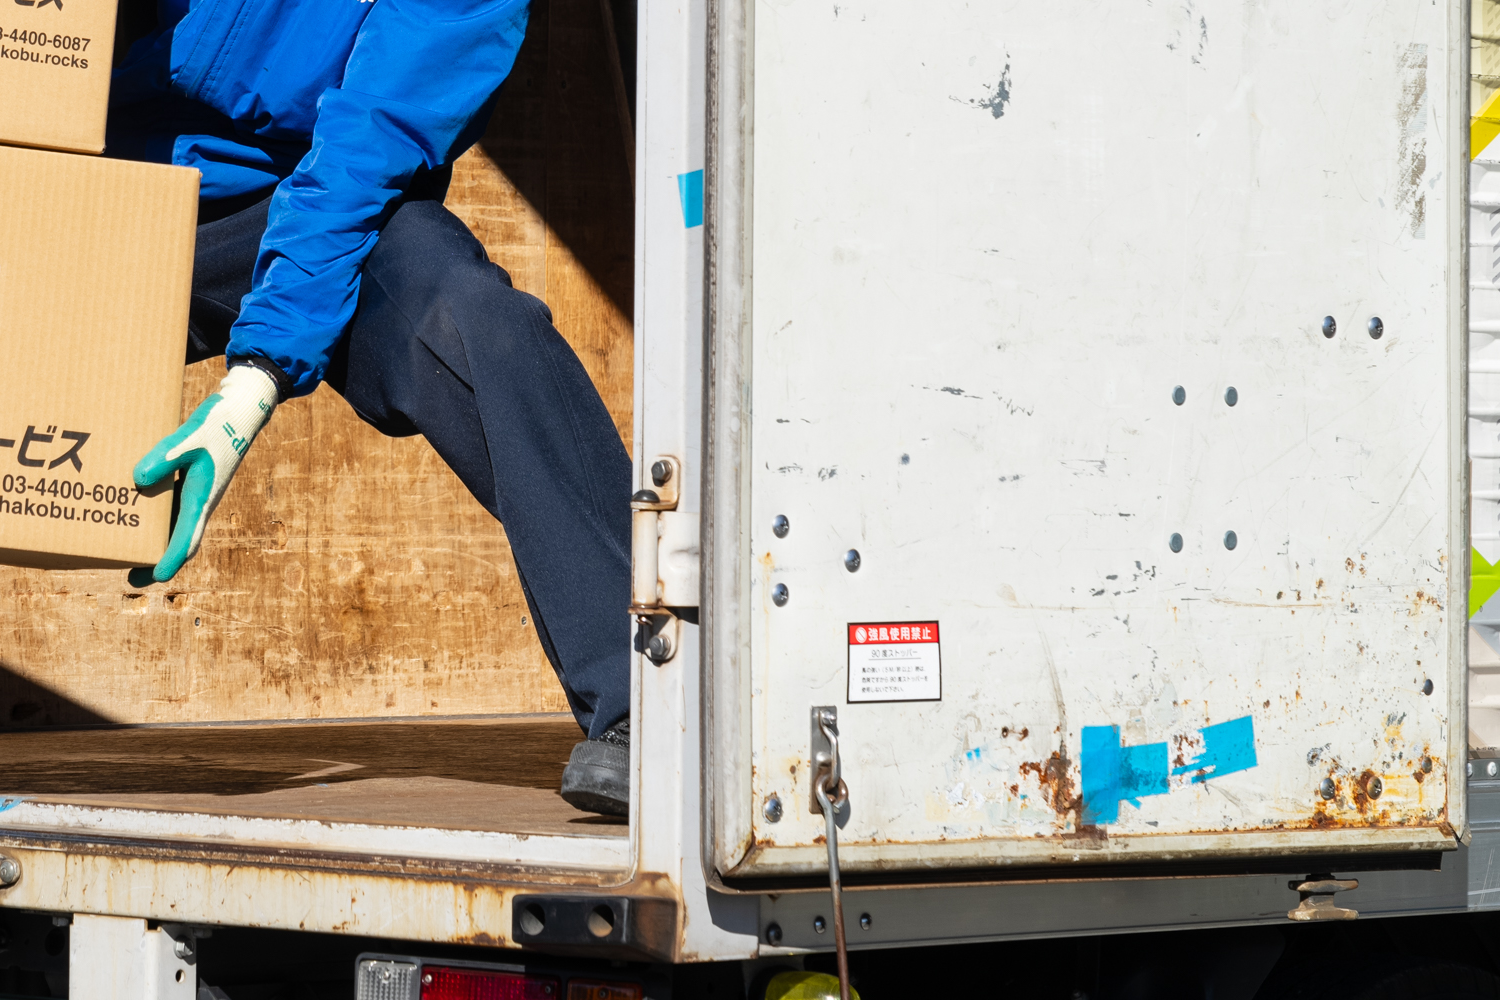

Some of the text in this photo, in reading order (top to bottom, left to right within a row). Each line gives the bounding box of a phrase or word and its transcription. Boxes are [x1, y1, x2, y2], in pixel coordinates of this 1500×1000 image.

[1, 473, 141, 508] 03-4400-6087
[868, 626, 932, 641] 強風使用禁止
